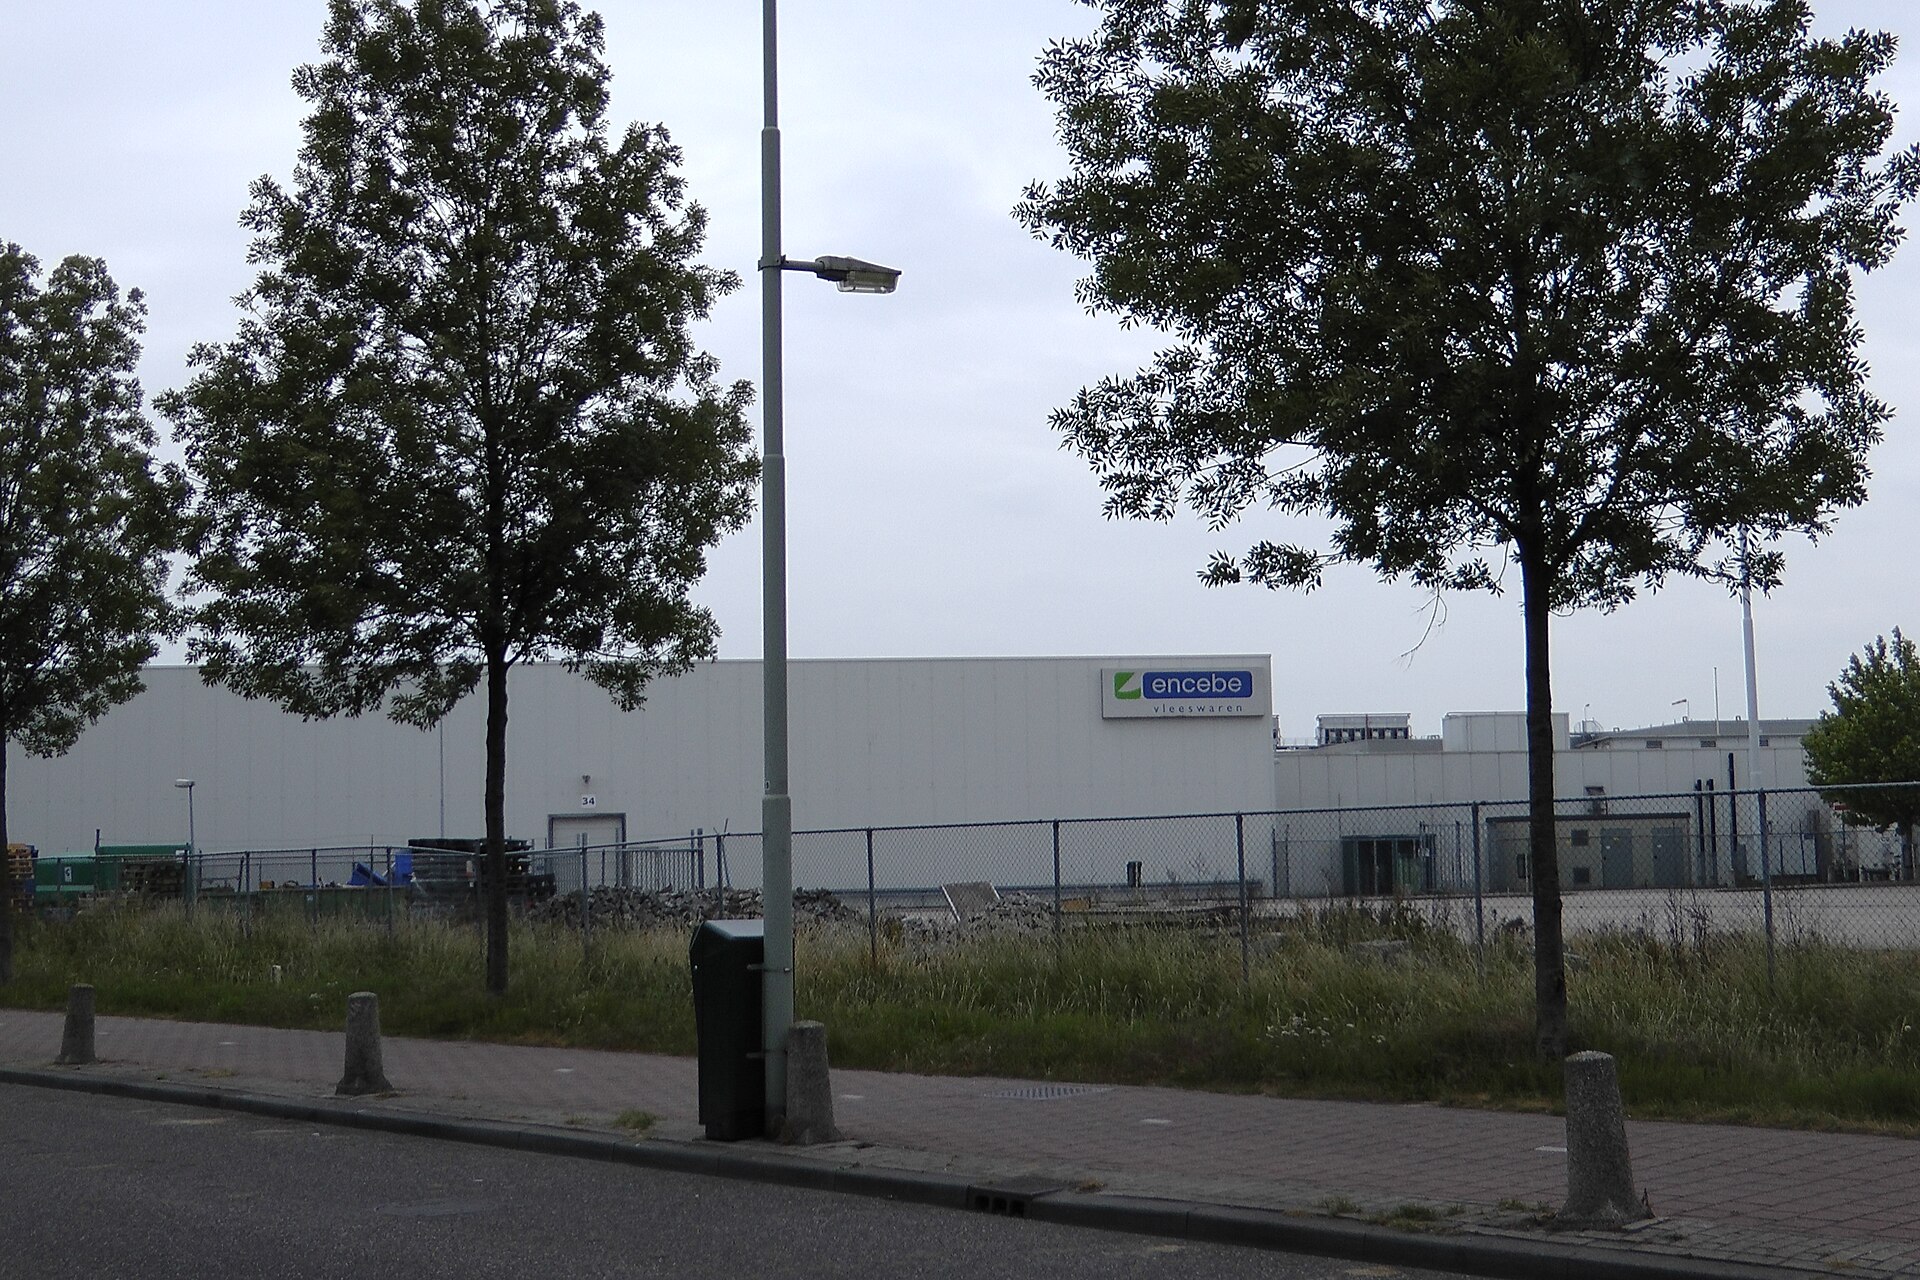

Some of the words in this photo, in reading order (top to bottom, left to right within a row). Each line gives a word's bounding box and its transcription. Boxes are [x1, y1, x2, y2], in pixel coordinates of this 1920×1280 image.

[1152, 673, 1242, 693] encebe
[1154, 703, 1242, 713] vleeswaren
[582, 797, 595, 805] 34
